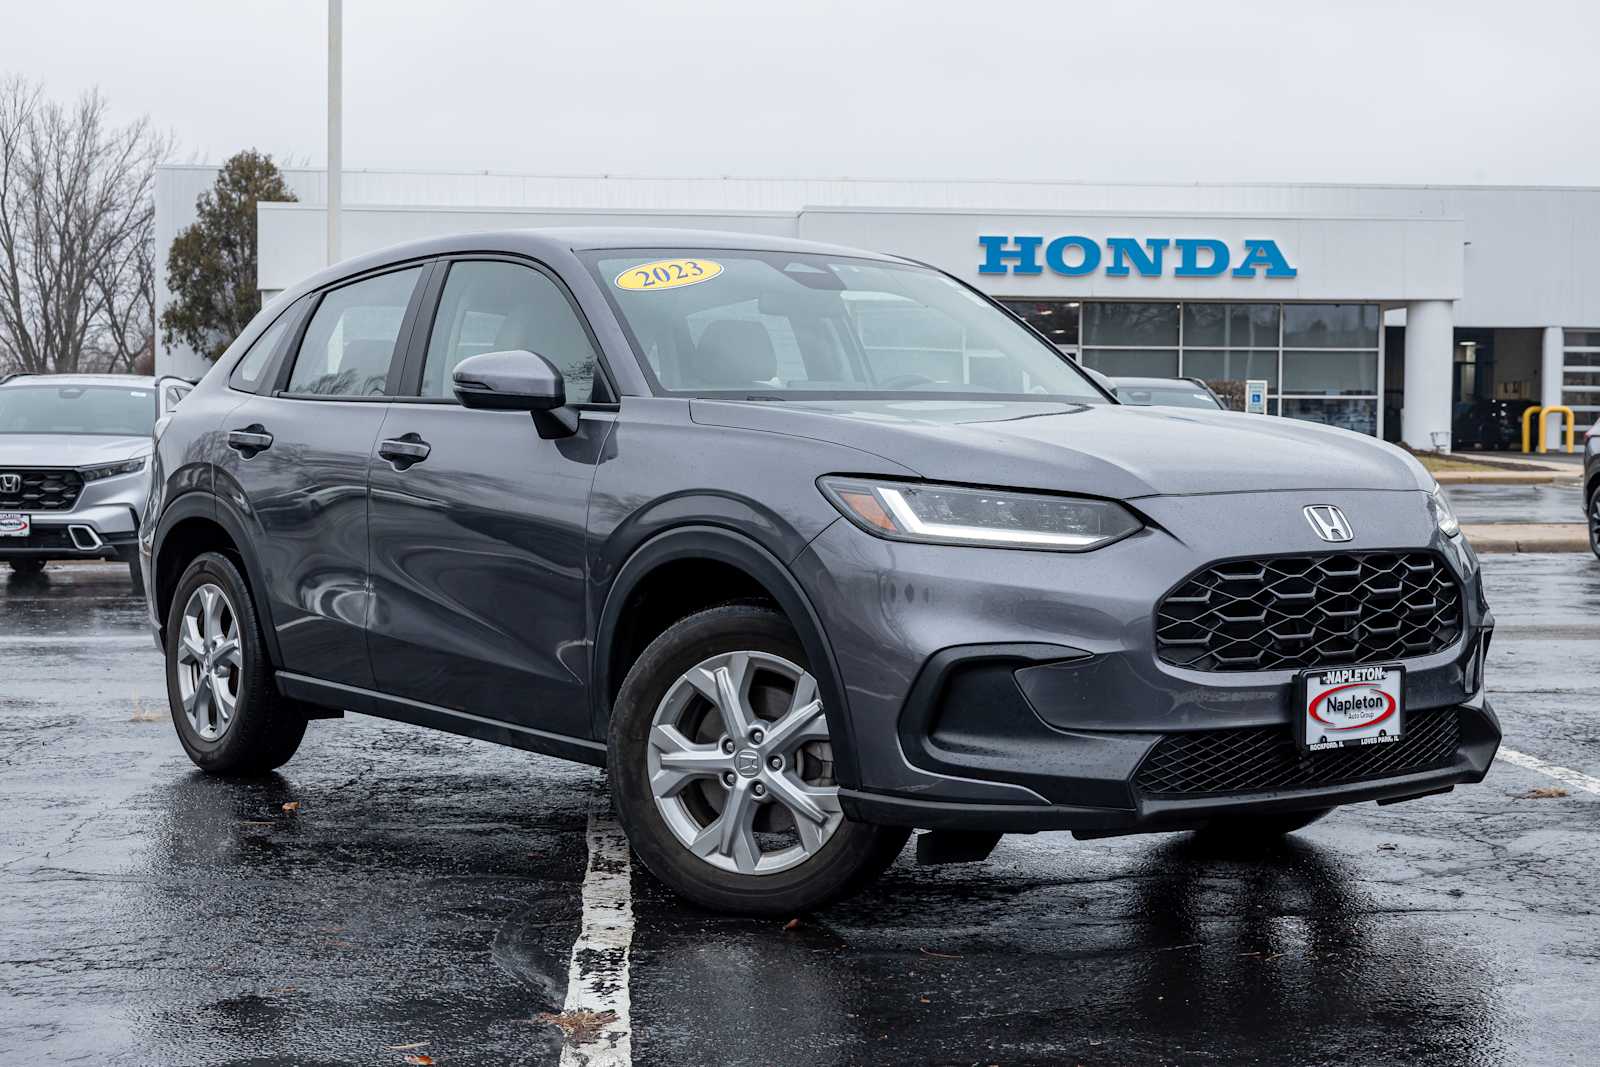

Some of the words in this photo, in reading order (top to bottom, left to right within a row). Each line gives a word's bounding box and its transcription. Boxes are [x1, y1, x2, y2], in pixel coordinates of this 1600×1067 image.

[978, 236, 1297, 278] HONDA
[635, 261, 704, 286] 2023
[1326, 668, 1383, 684] NAPLETON
[1326, 695, 1383, 714] Napleton
[1360, 711, 1375, 719] Group
